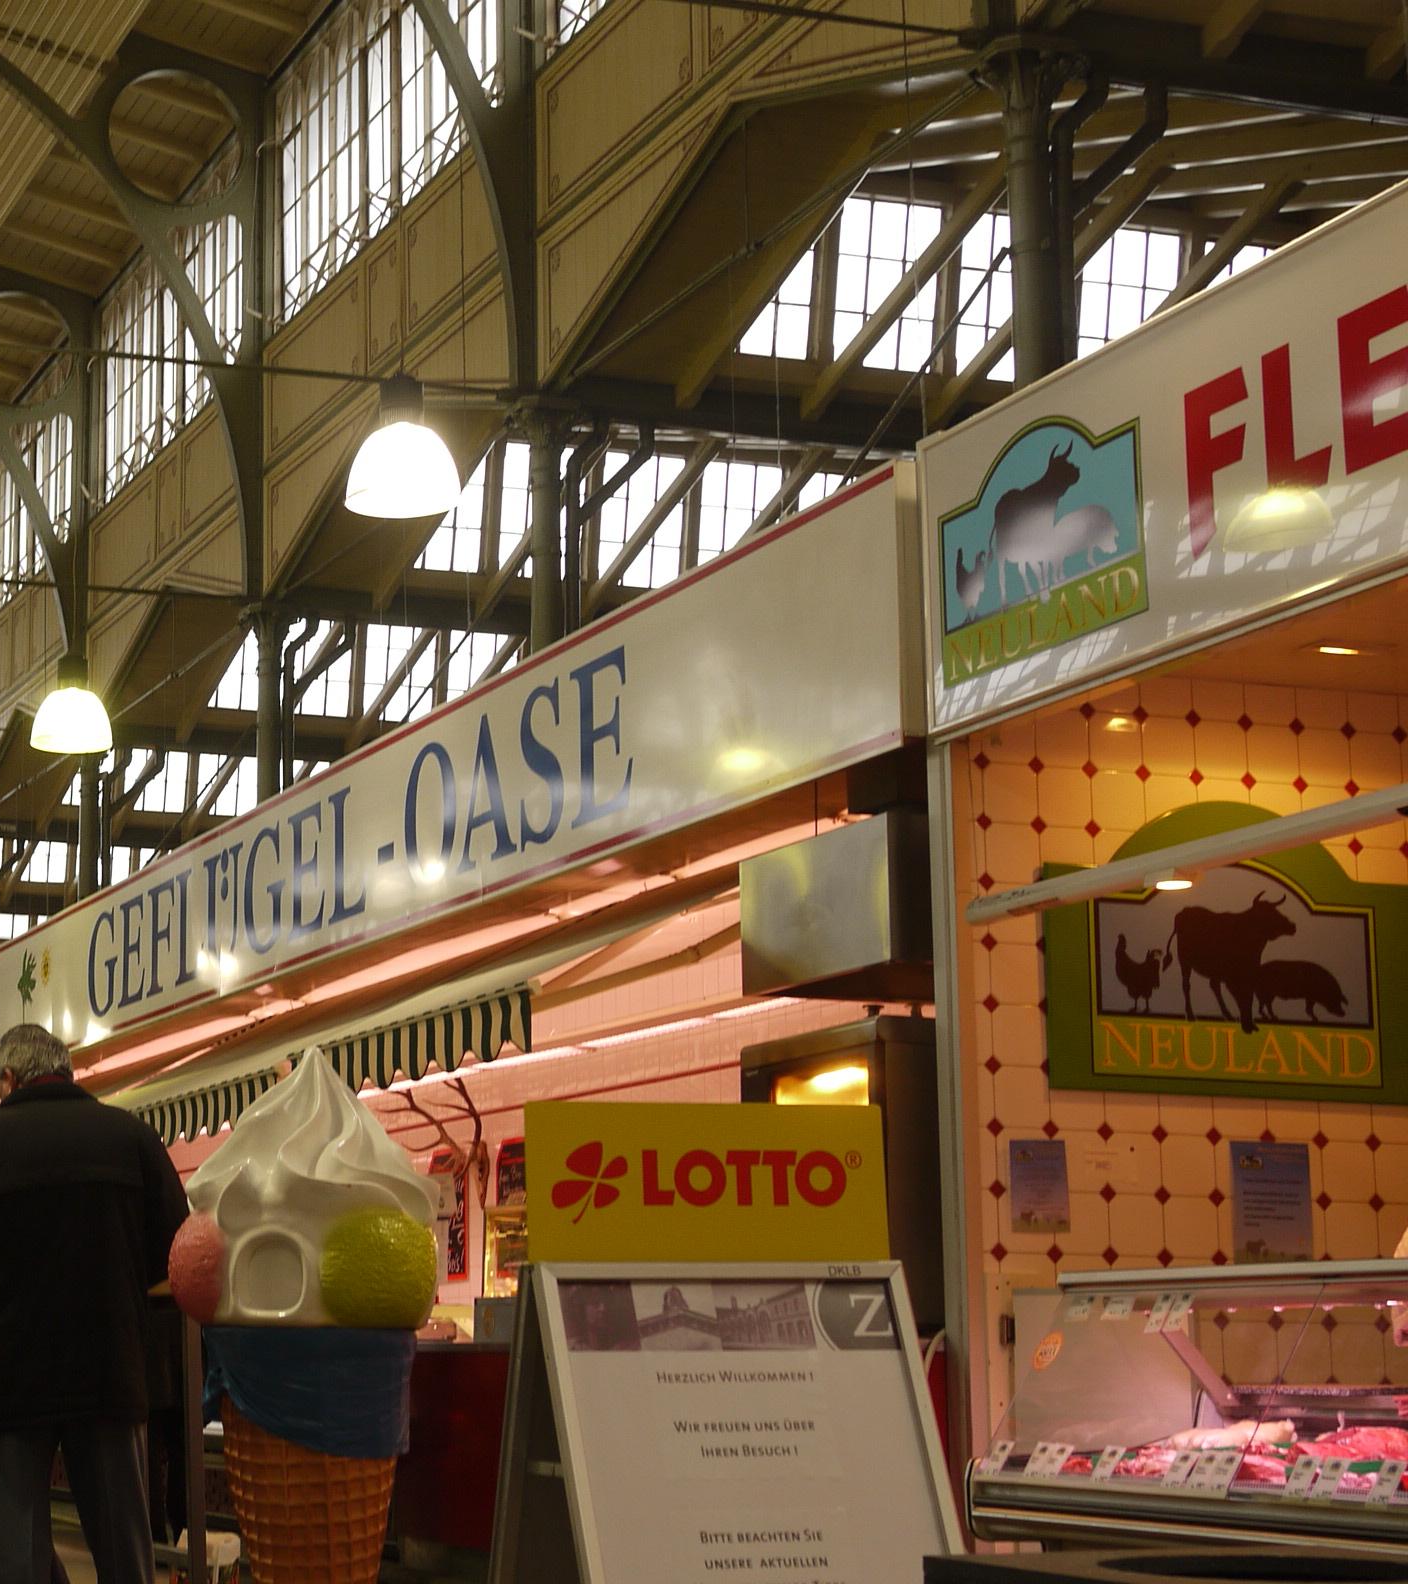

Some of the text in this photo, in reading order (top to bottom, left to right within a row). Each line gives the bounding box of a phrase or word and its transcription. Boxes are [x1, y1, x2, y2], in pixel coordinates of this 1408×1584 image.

[949, 564, 1141, 683] NEULAND
[1101, 1020, 1377, 1080] NEULAND
[827, 1264, 862, 1278] DKLB
[849, 1293, 894, 1336] Z
